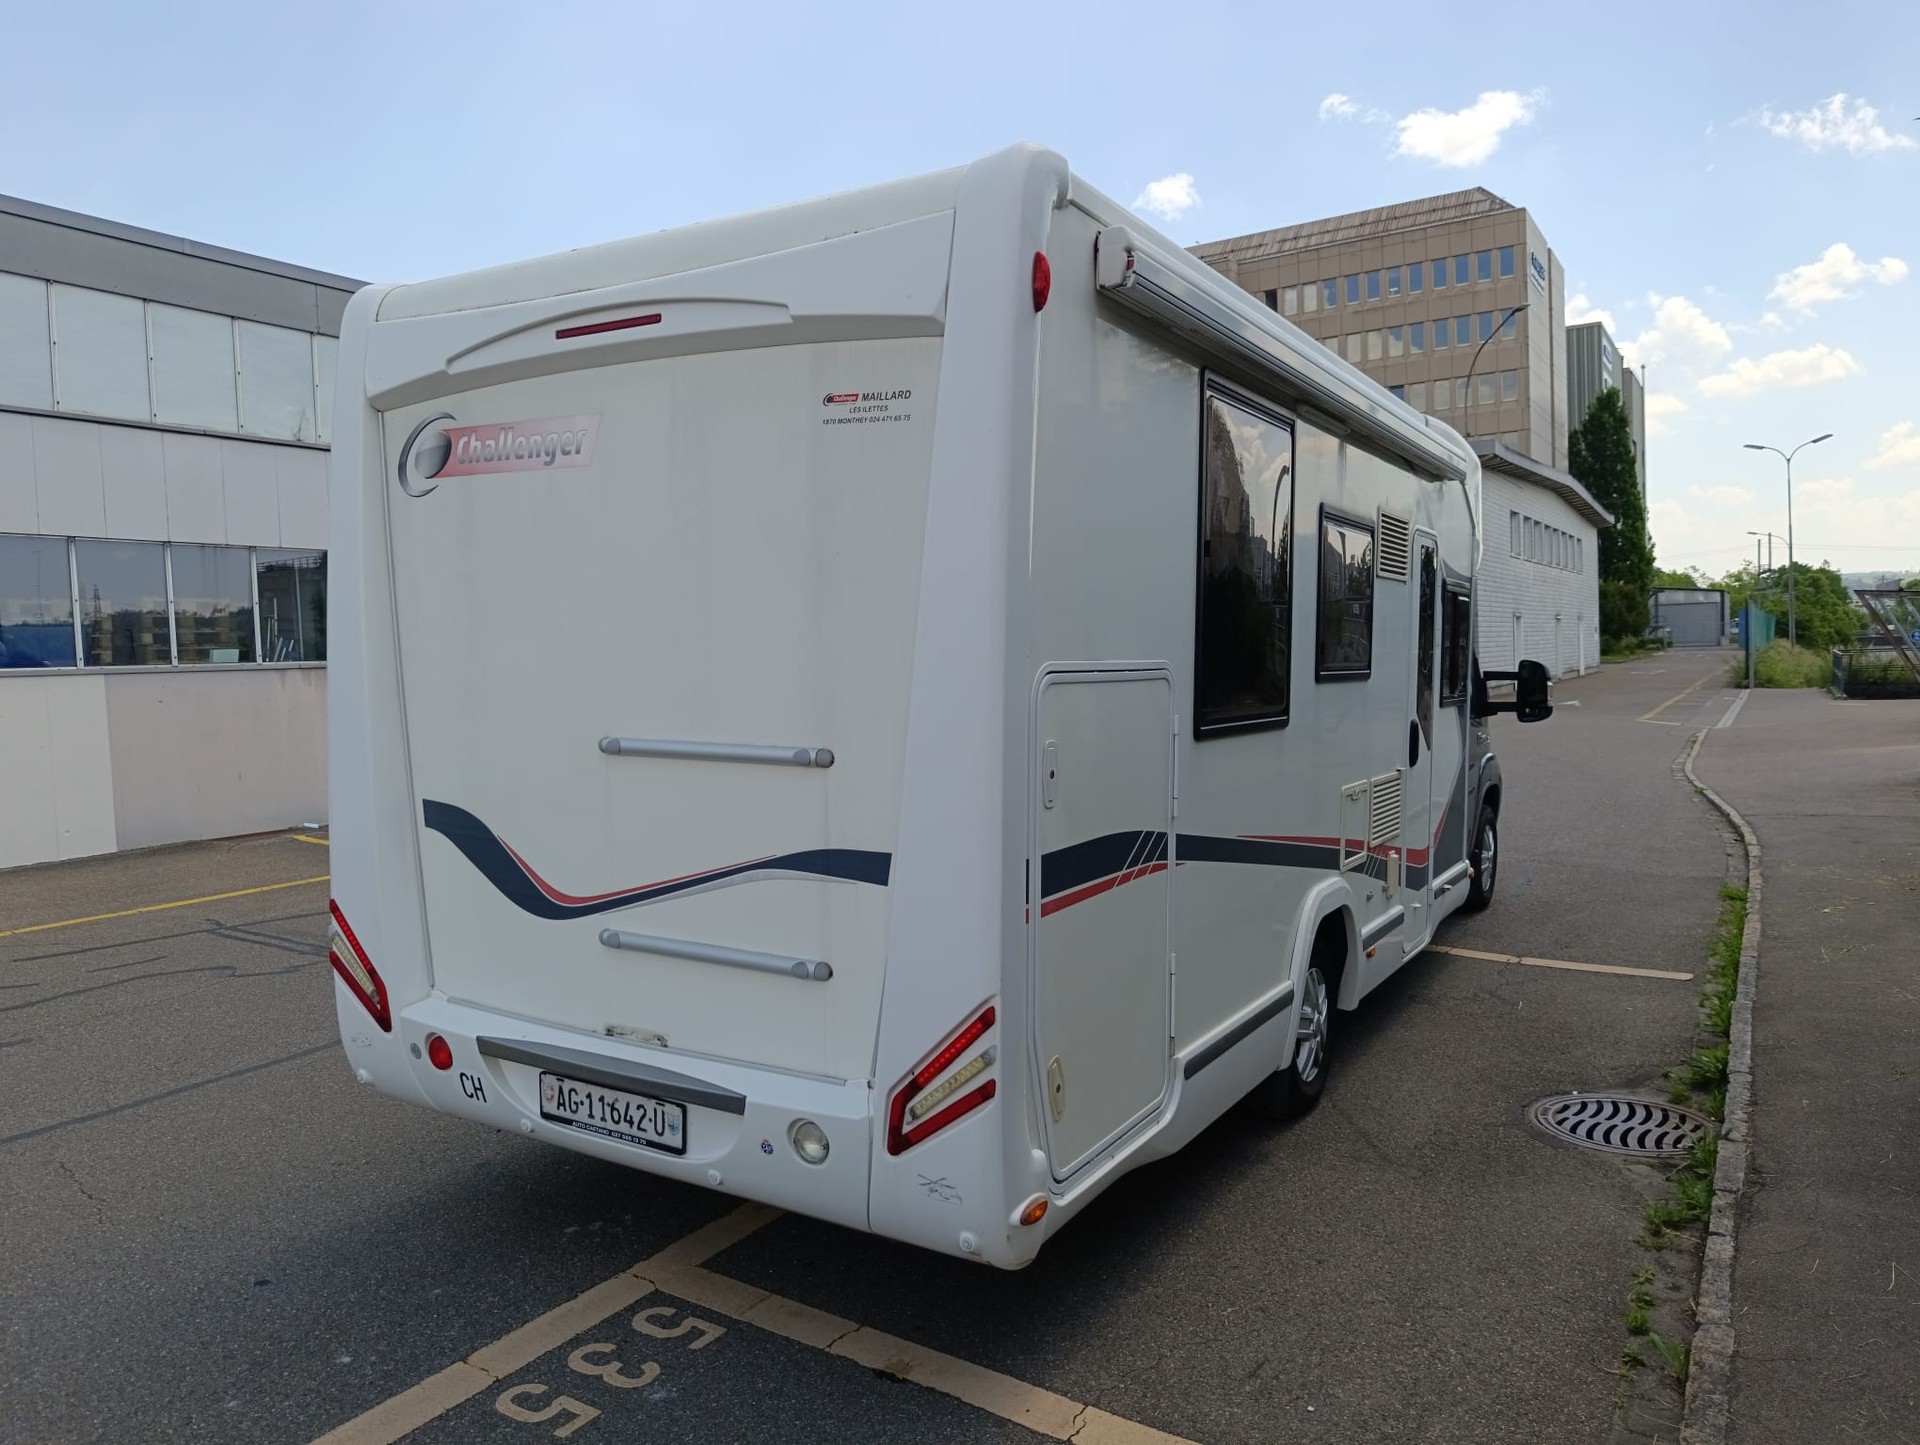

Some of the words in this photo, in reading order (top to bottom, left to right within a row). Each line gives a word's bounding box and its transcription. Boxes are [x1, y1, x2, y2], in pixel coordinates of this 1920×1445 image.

[861, 390, 911, 402] MAILLARD
[849, 406, 861, 414] LES
[837, 416, 868, 425] MONTHEY
[456, 426, 587, 467] Challenger
[459, 1071, 488, 1103] CH
[572, 1120, 586, 1129] AUTO
